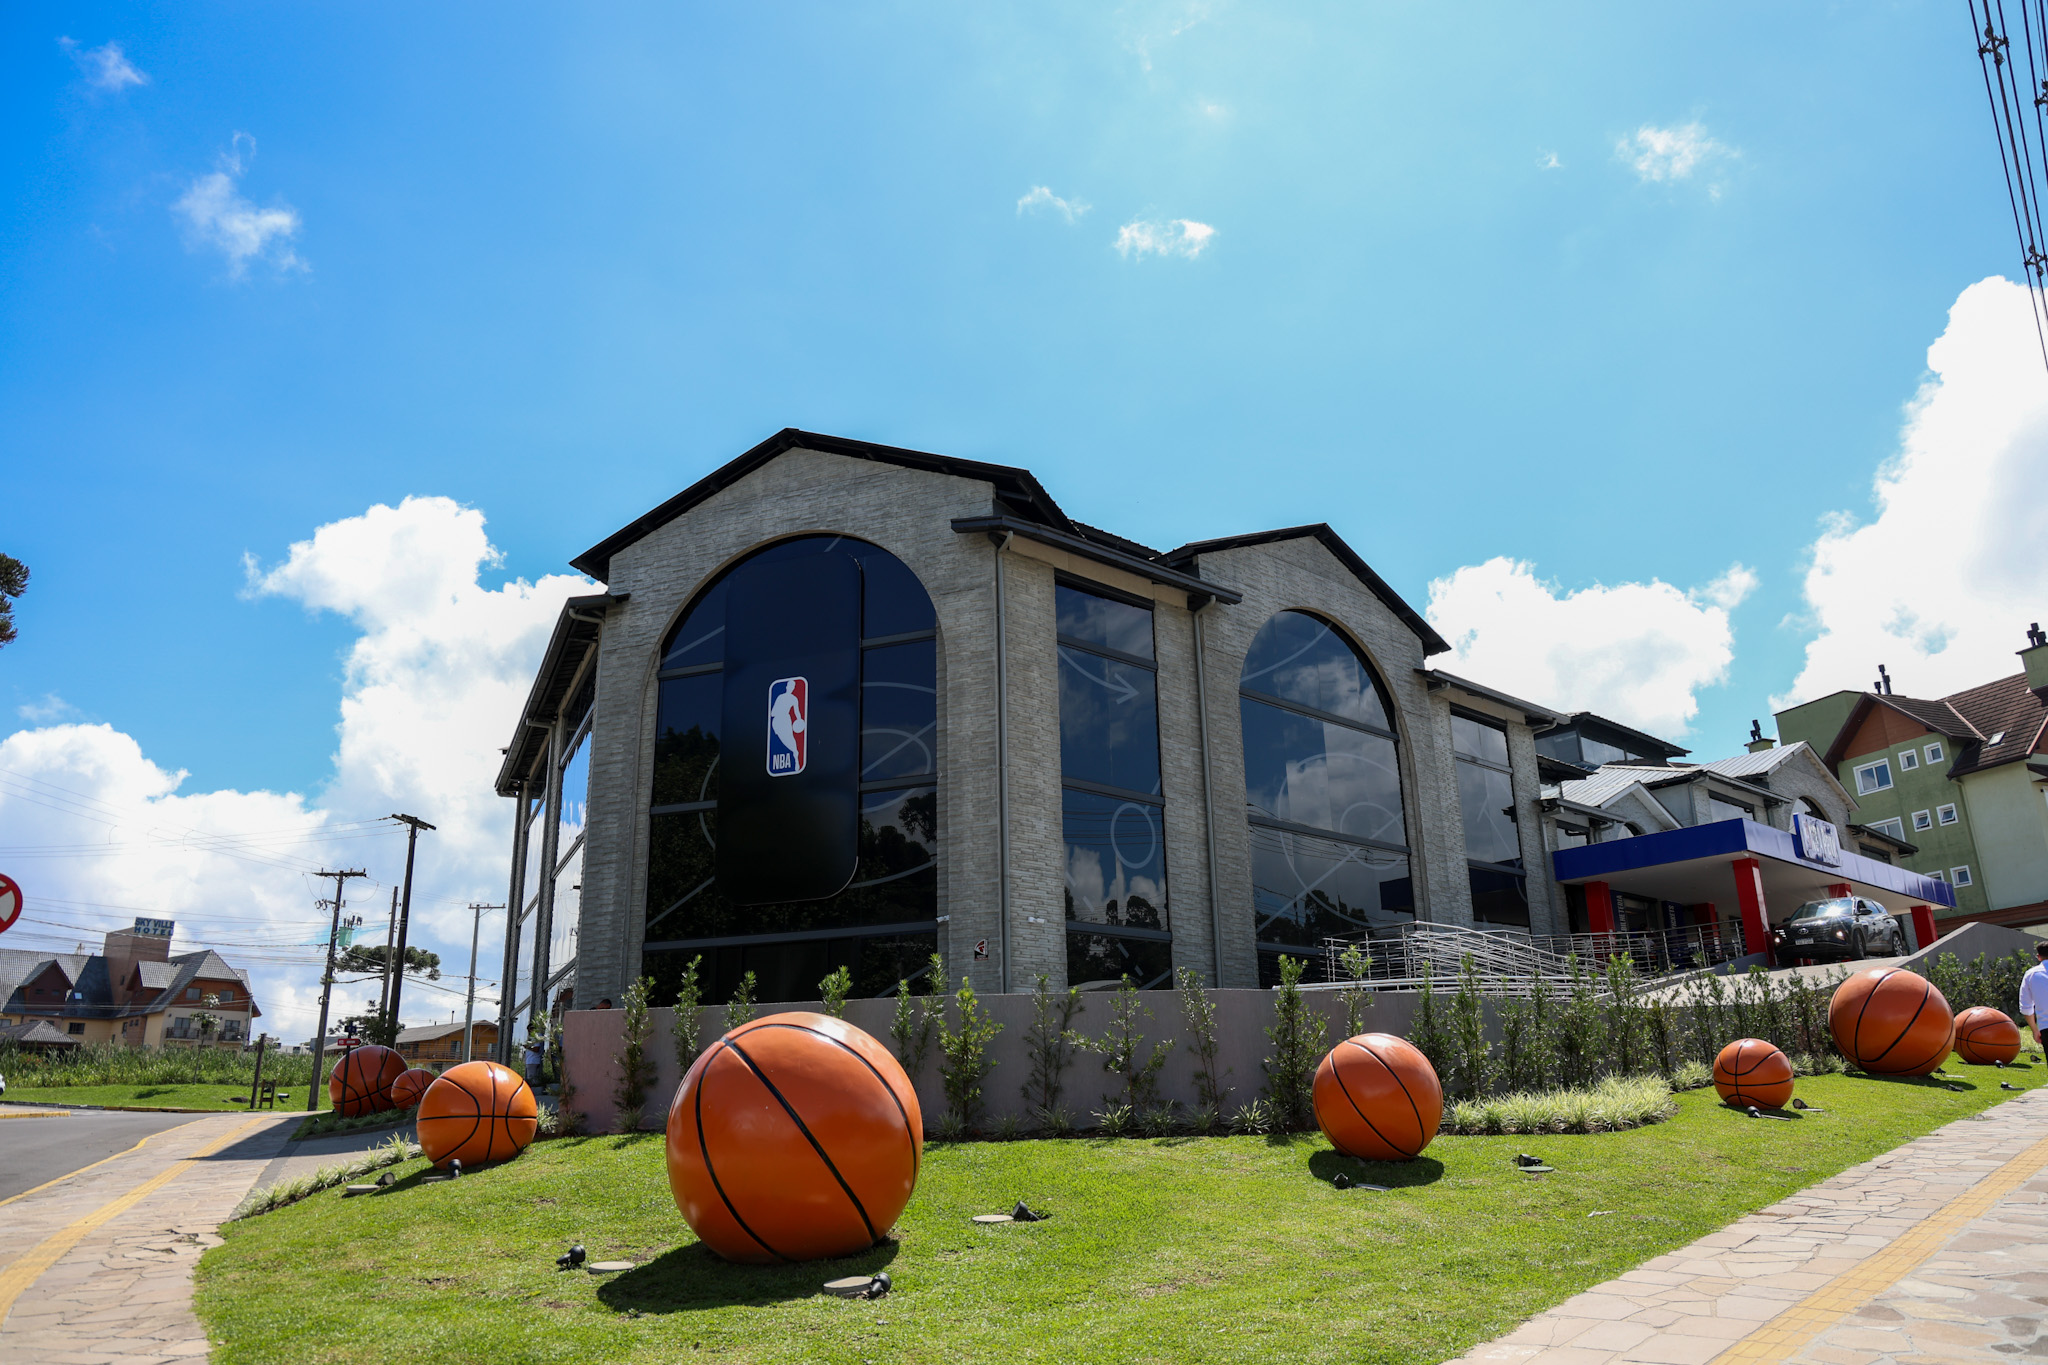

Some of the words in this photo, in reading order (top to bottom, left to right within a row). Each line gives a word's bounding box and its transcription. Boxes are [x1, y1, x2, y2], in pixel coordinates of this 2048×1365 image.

[773, 753, 791, 770] NBA
[1616, 895, 1628, 932] BILHETERIA
[135, 917, 151, 926] SKY
[153, 920, 175, 929] VILLE
[134, 926, 174, 937] HOTEL
